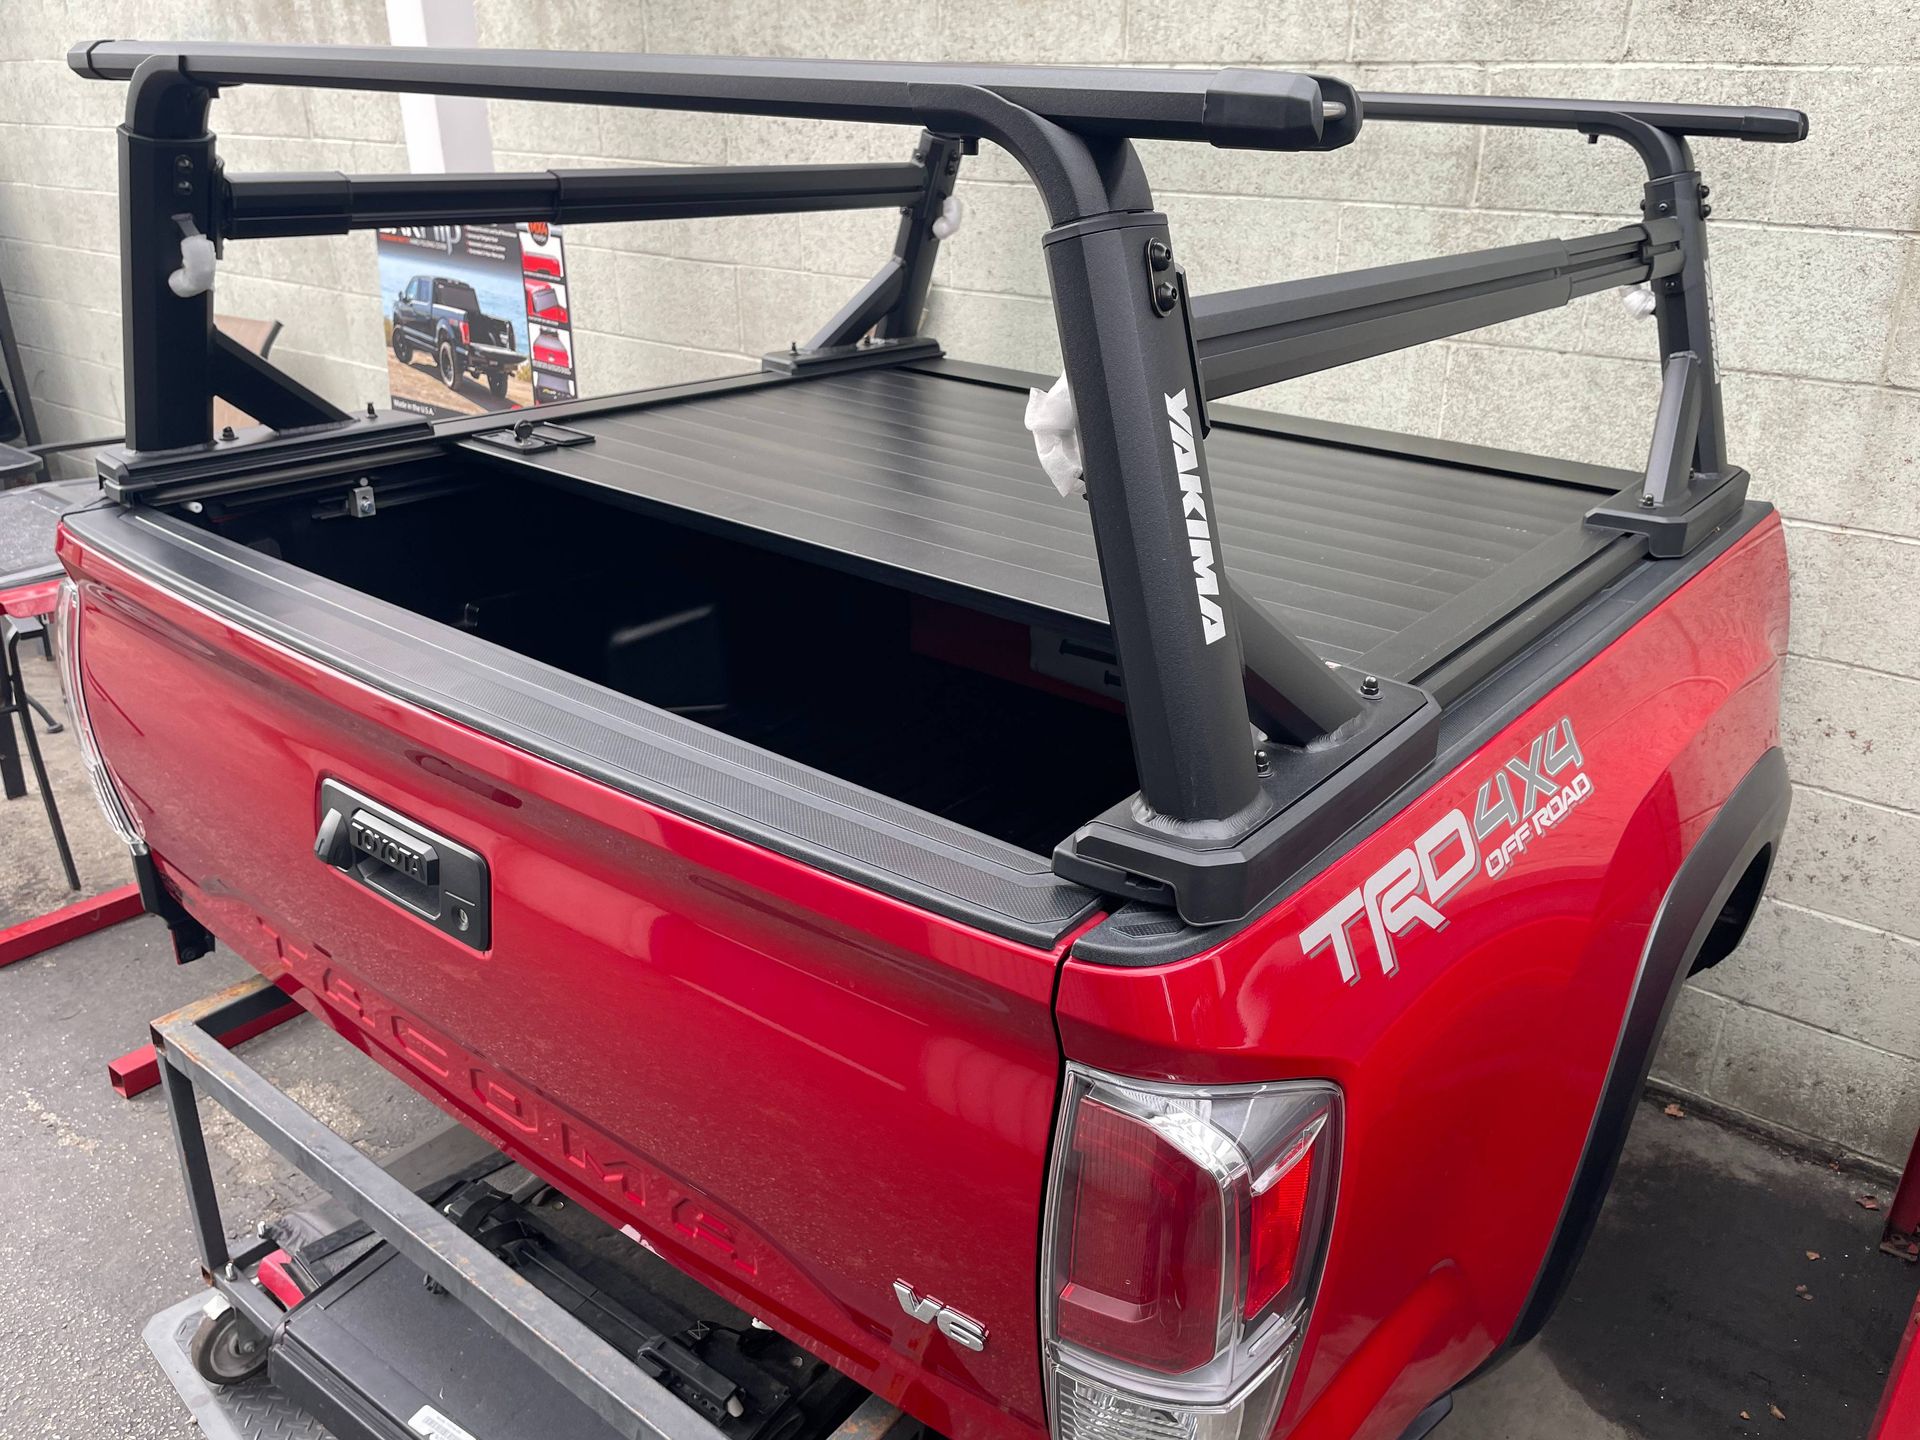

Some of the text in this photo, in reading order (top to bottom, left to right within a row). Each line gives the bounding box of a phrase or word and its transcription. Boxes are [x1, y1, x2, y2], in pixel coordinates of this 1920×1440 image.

[1164, 388, 1227, 646] YAKIMA
[351, 821, 426, 884] TOYOTA
[1299, 716, 1584, 986] TRD 4X4
[1485, 772, 1594, 880] OFF ROAD
[256, 915, 759, 1276] TACOMA
[893, 1280, 986, 1352] V6
